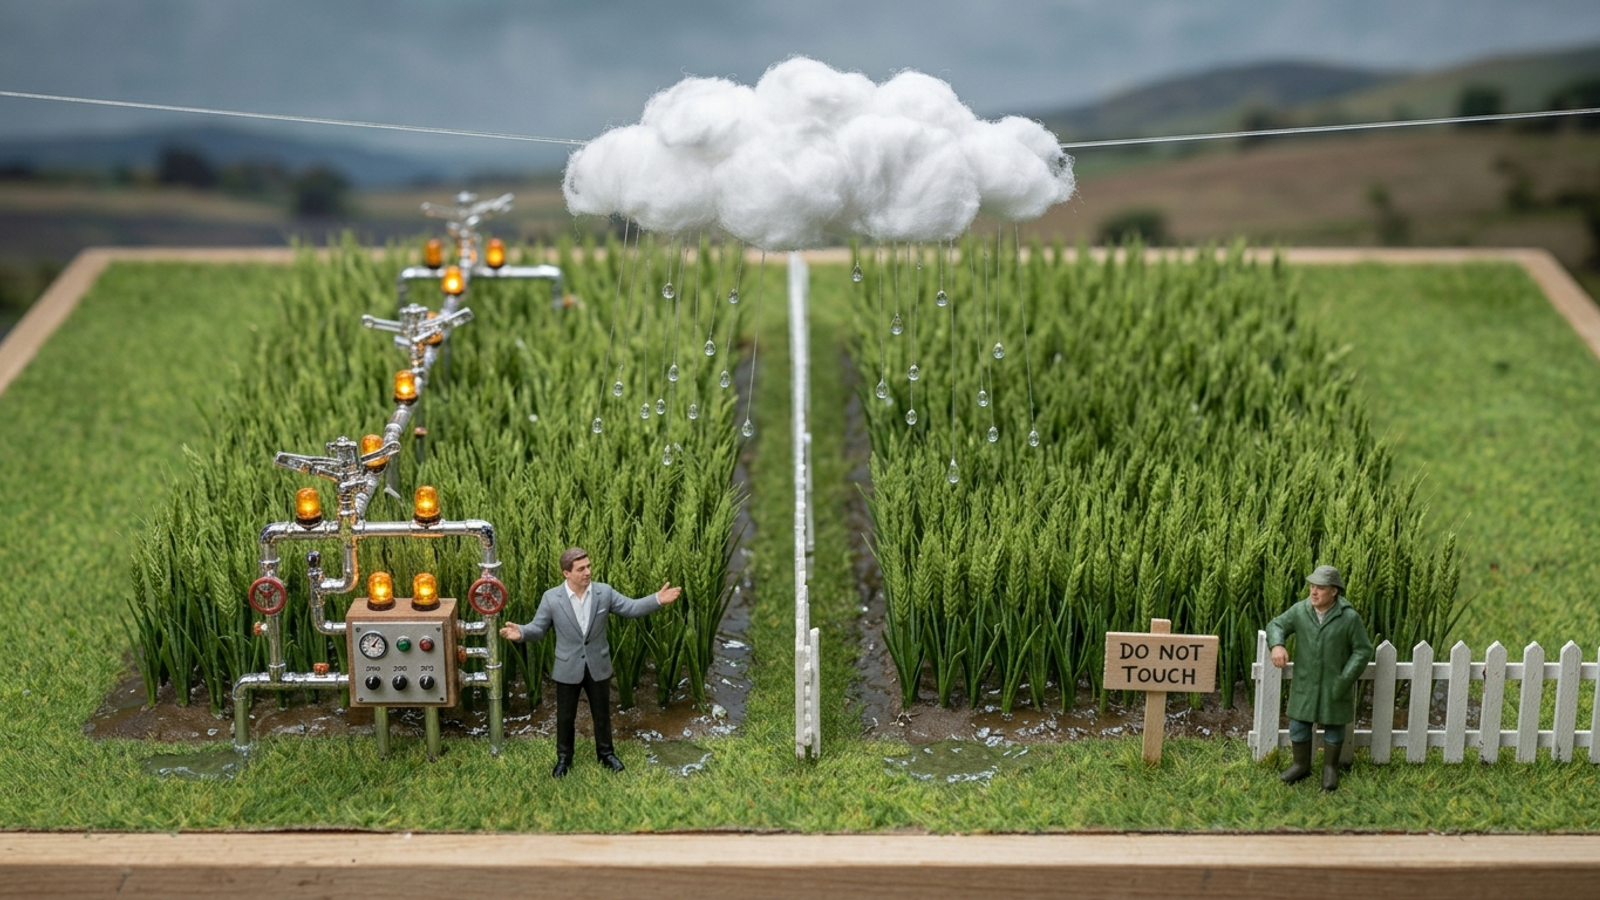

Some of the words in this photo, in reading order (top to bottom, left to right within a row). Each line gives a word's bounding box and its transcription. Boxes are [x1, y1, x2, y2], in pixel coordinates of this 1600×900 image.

[1120, 643, 1149, 659] DO
[1159, 644, 1204, 661] NOT
[1121, 666, 1195, 685] TOUCH
